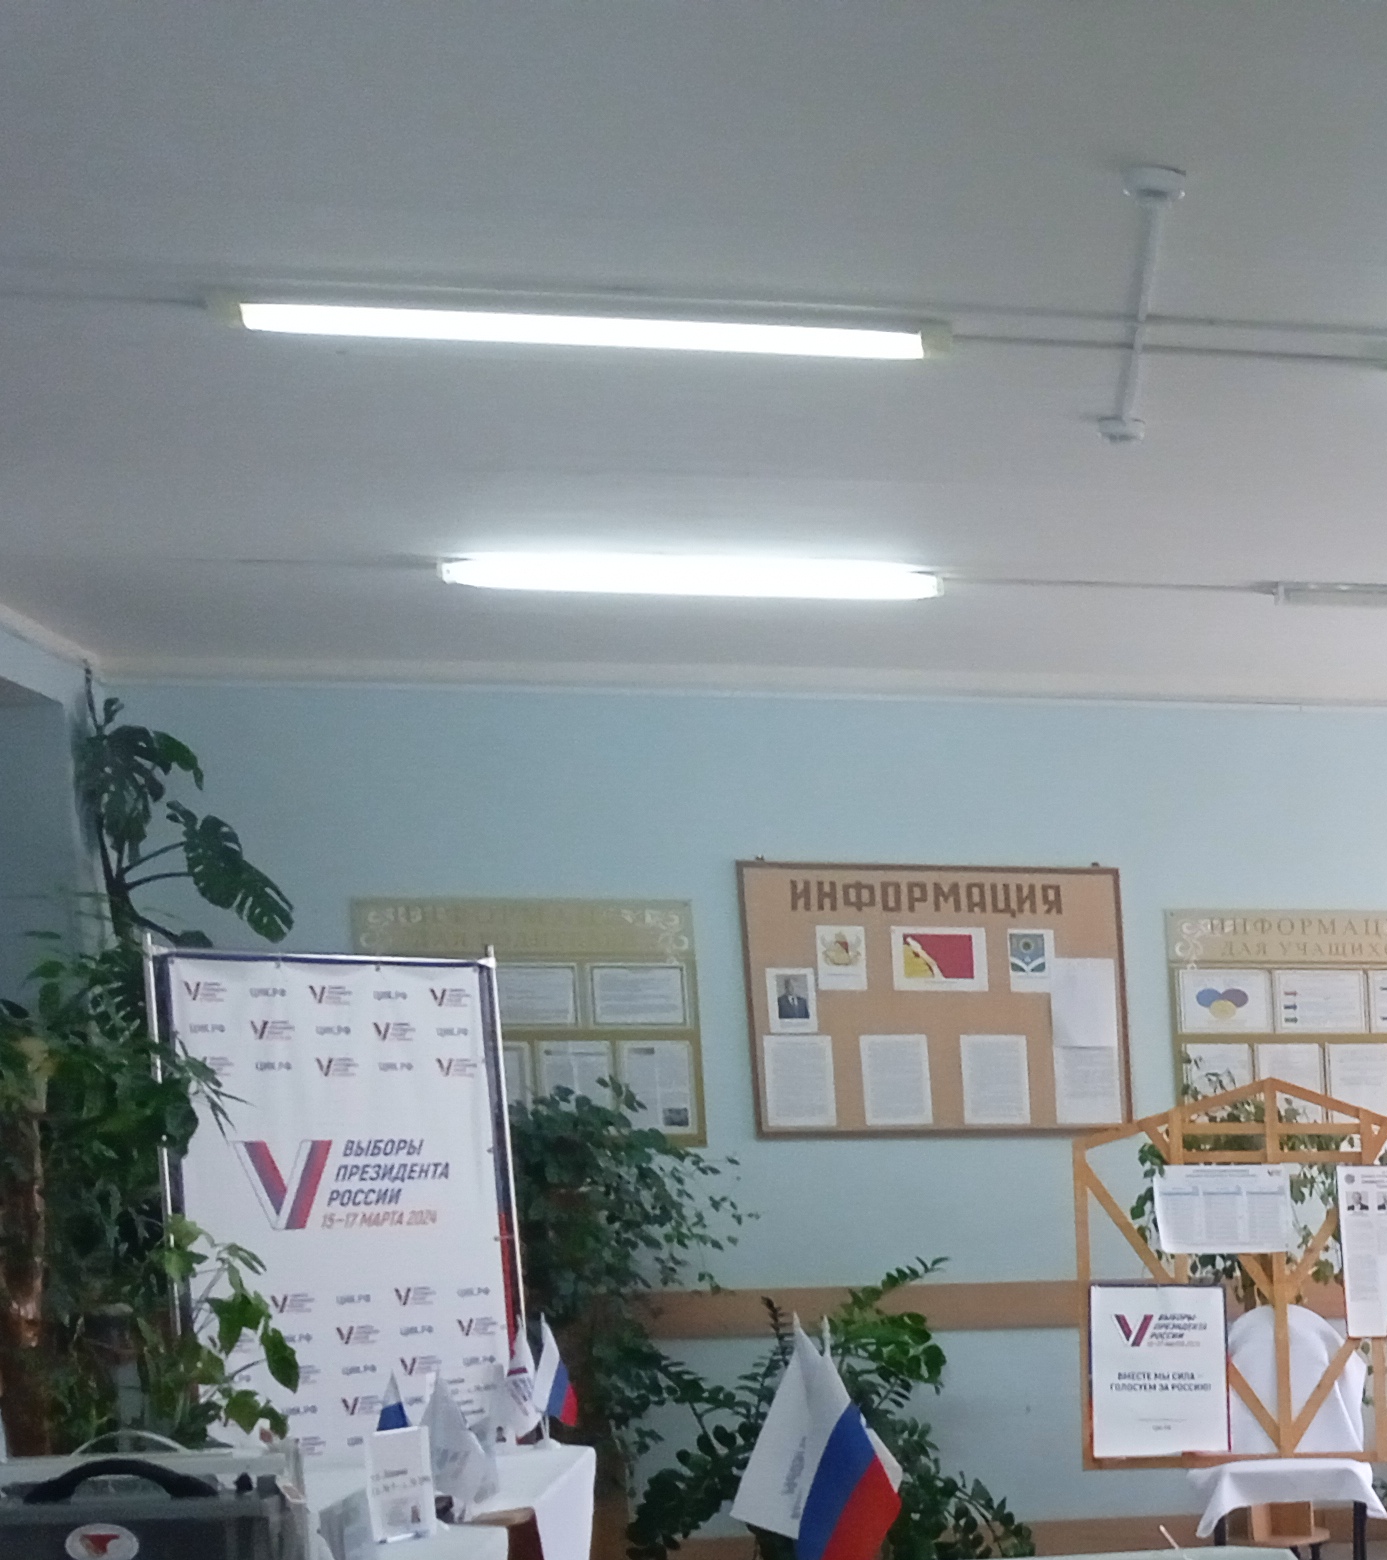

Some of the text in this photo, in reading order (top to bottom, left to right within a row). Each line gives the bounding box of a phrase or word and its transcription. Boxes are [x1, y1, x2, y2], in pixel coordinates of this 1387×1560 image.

[789, 878, 1063, 918] ИНФОРМАЦИЯ
[1221, 941, 1268, 957] ДЛЯ
[342, 1138, 425, 1158] ВЫБОРЫ
[334, 1162, 450, 1184] ПРЕЗИДЕНТА
[326, 1188, 403, 1208] РОССИИ
[359, 1212, 404, 1228] МАРТА
[406, 1209, 438, 1225] 2024
[1117, 1371, 1196, 1382] ВМЕСТЕ МЫ СИЛА
[1109, 1383, 1157, 1393] ГОЛОСУЕМ
[1158, 1383, 1169, 1393] ЗА
